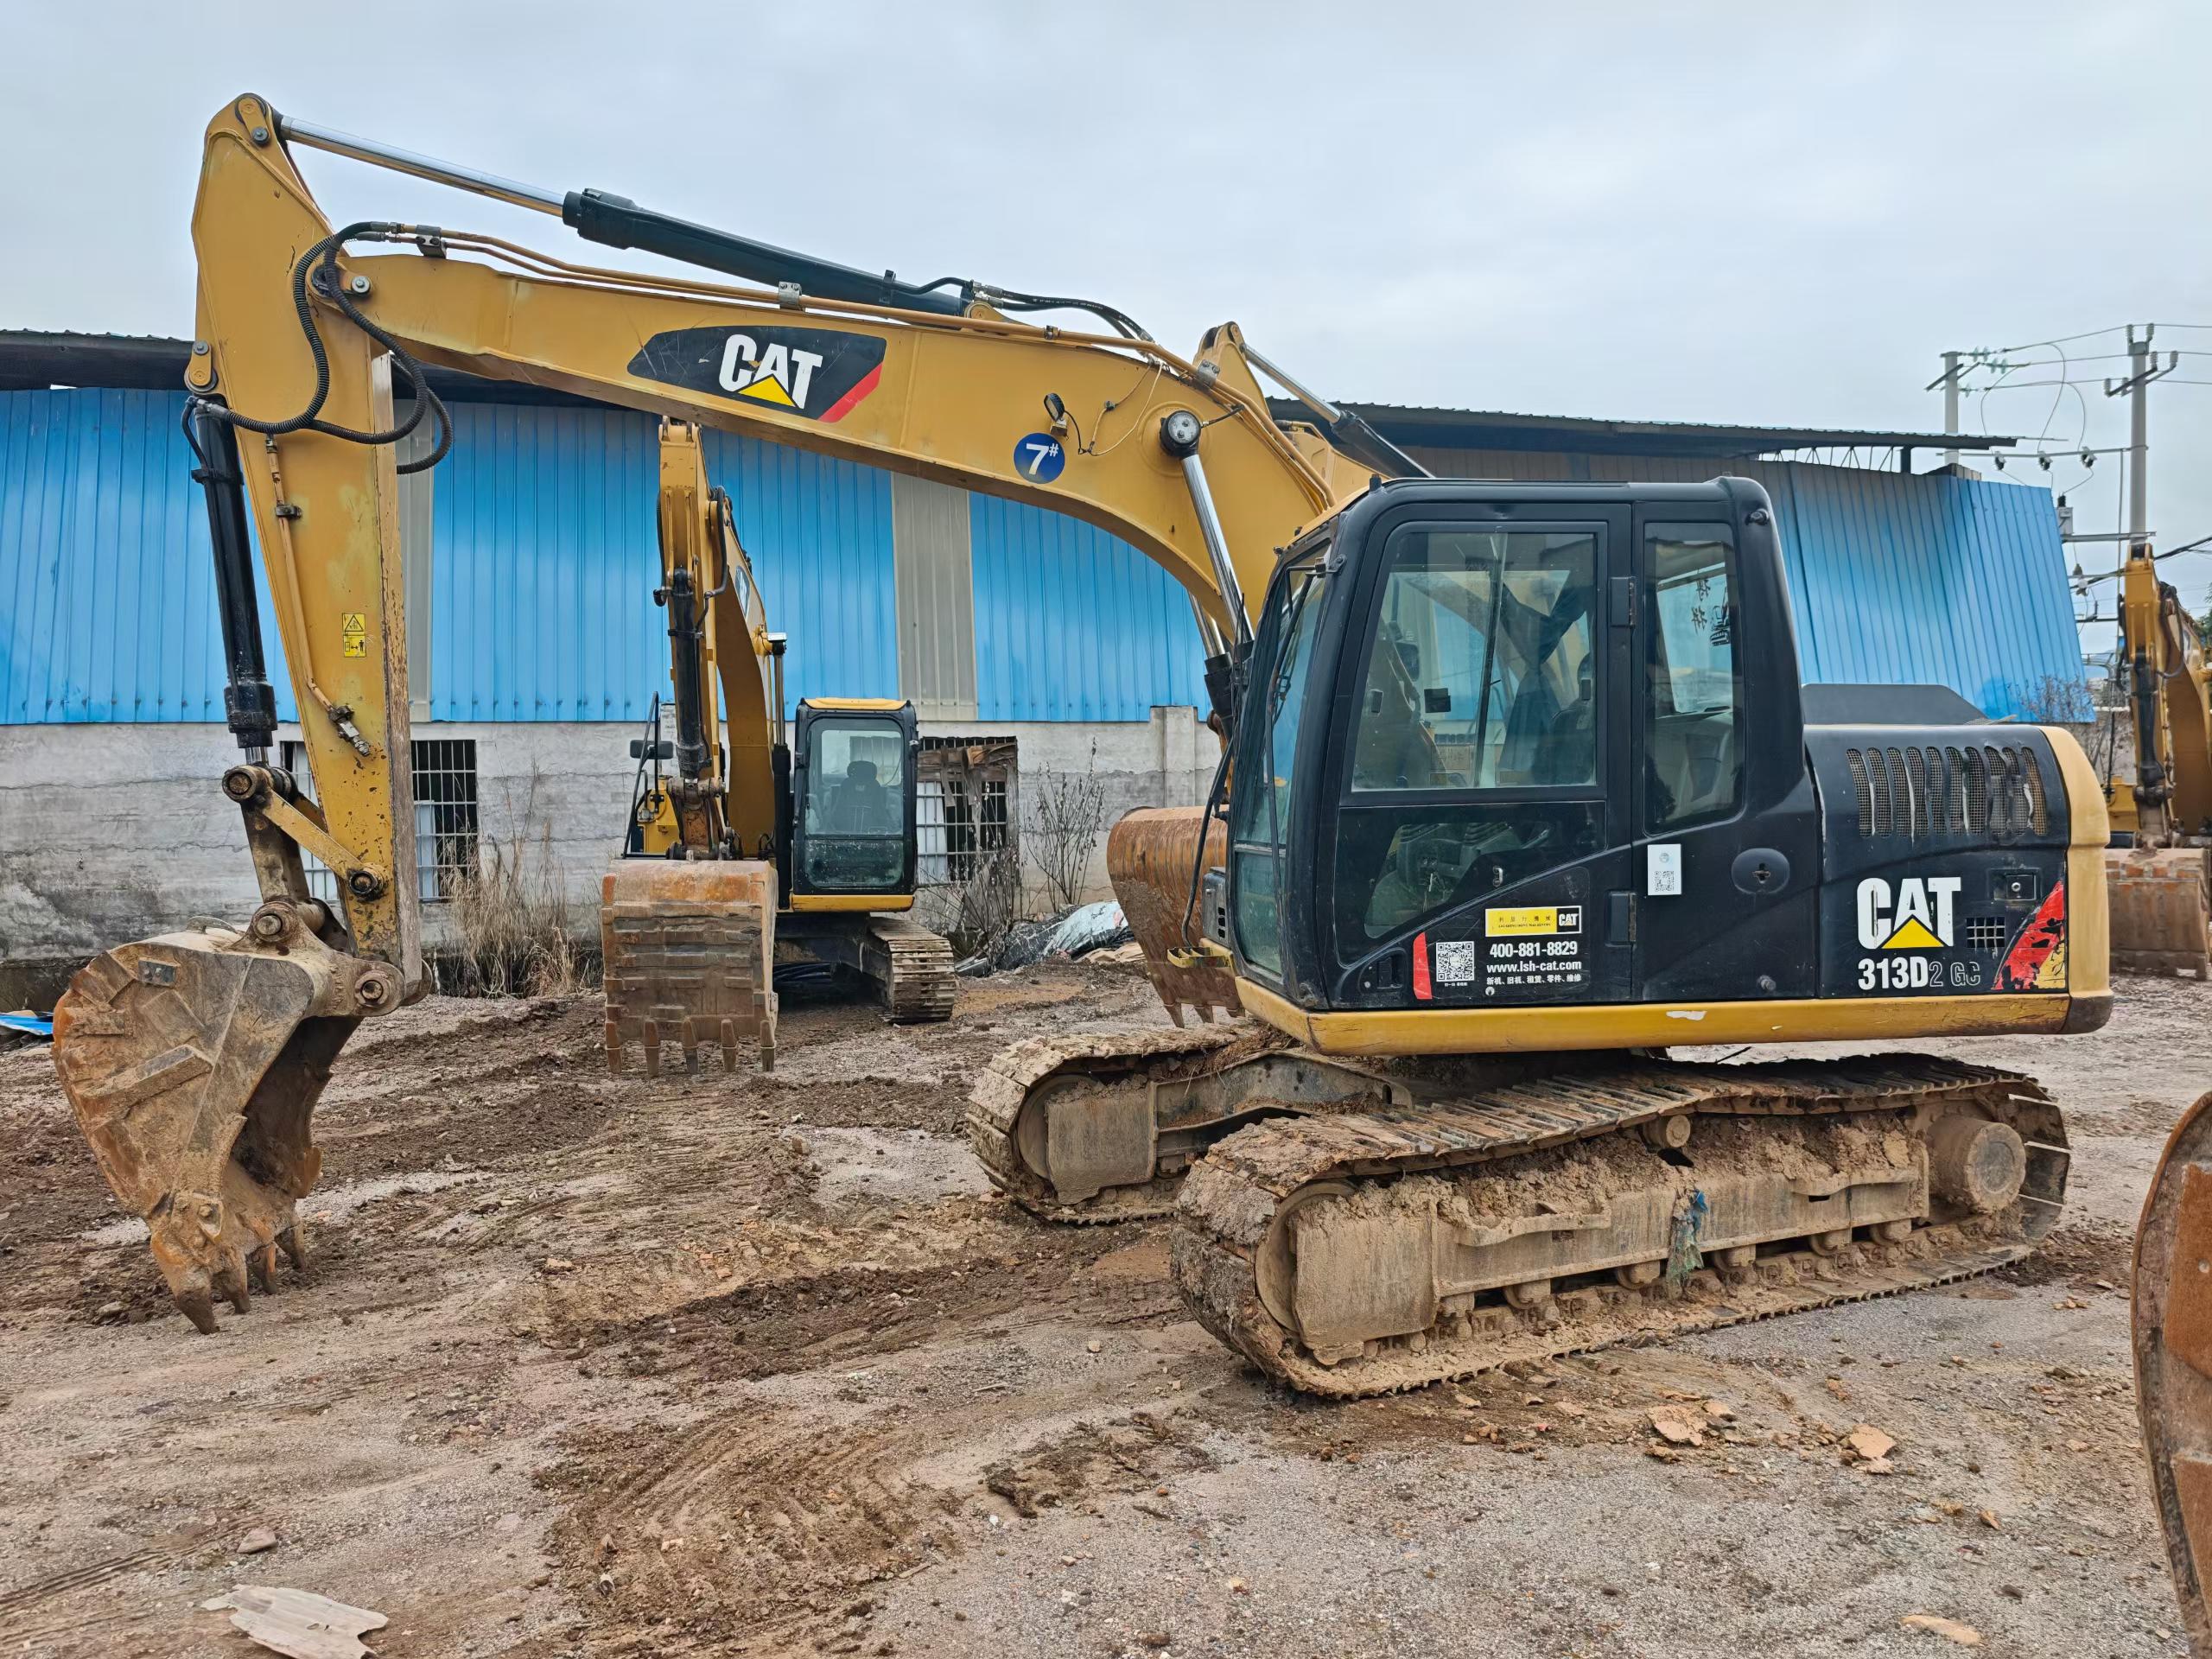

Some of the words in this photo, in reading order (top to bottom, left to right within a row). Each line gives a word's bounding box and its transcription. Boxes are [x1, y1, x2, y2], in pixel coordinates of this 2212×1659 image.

[719, 334, 823, 409] CAT
[1558, 913, 1579, 926] CAT
[1857, 876, 1961, 950] CAT
[1489, 941, 1578, 957] 400-881-8829
[1486, 960, 1582, 973] www.lsh-cat.com
